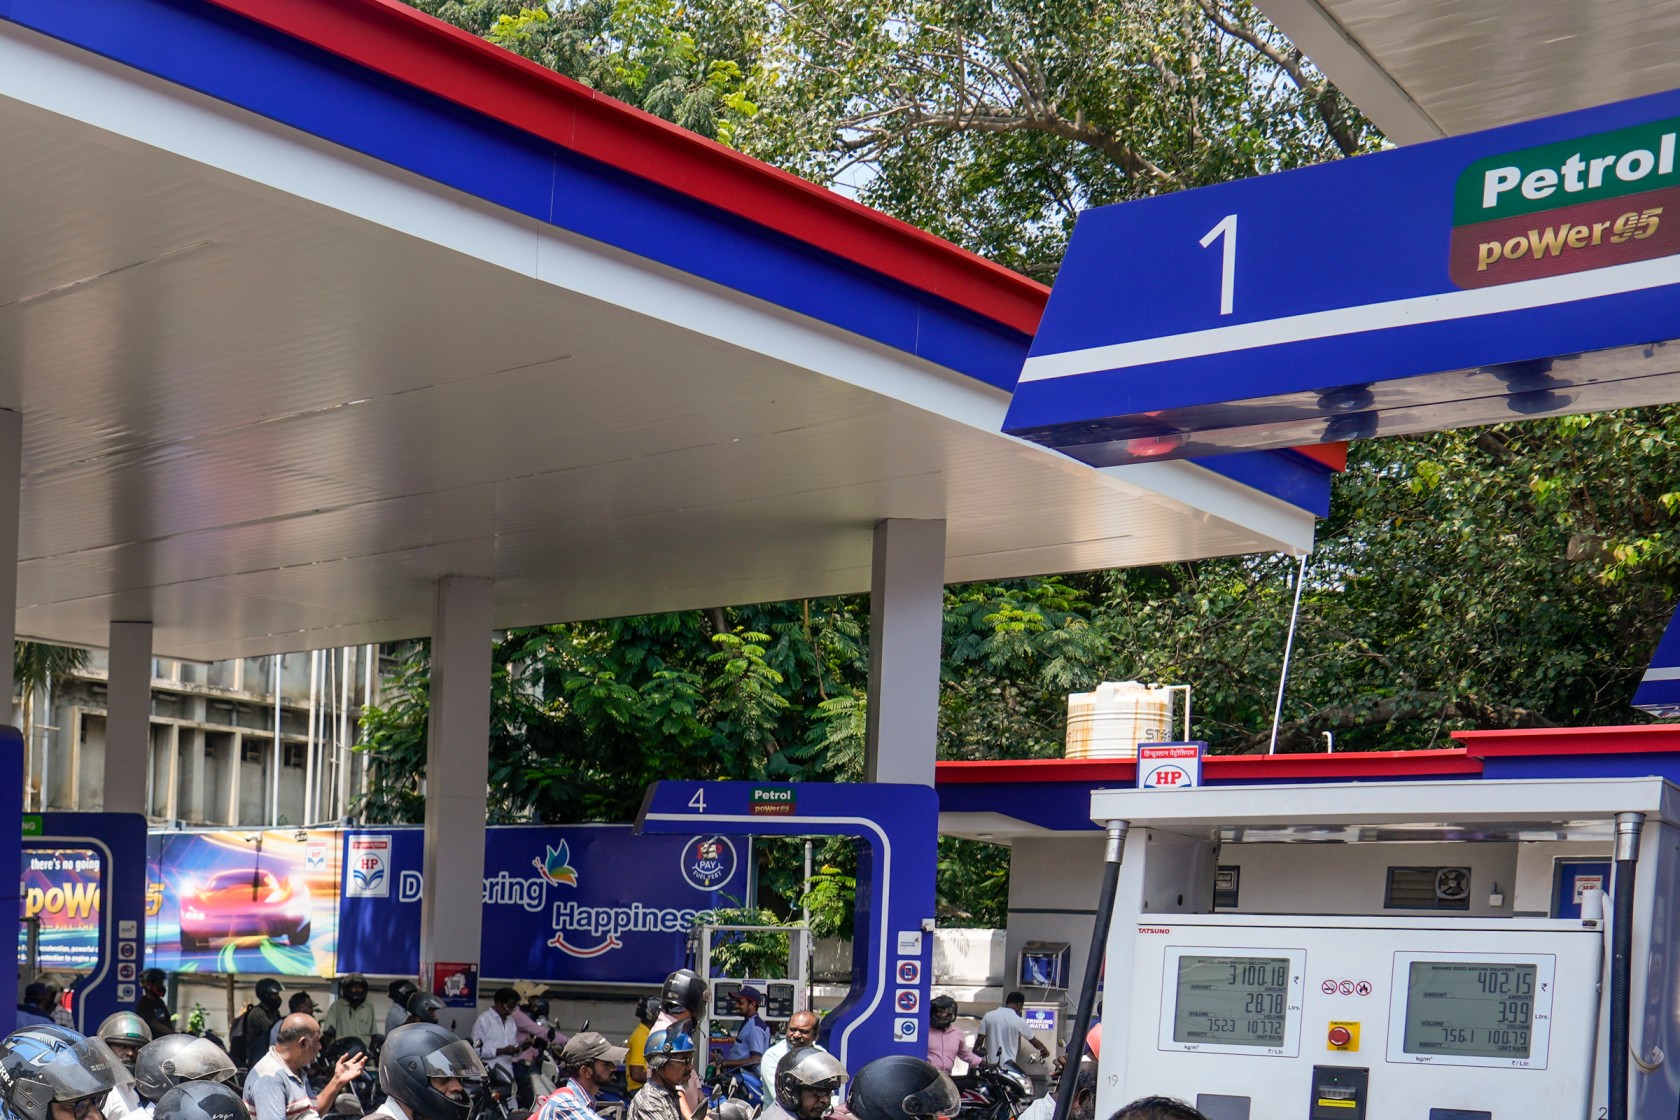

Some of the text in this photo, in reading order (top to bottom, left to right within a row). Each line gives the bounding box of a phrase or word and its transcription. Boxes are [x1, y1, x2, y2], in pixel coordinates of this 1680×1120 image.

[1482, 133, 1677, 209] Petrol
[1199, 214, 1238, 316] 1
[1155, 771, 1182, 785] HP
[687, 787, 707, 813] 4
[754, 790, 791, 800] Petrol
[30, 858, 101, 873] there's no going
[360, 858, 379, 870] HP
[699, 860, 717, 870] PAY
[1477, 971, 1532, 995] 402.15
[1245, 993, 1284, 1014] 28.78
[1497, 1001, 1529, 1024] 3.99
[1441, 1028, 1474, 1044] 756.1
[1488, 1030, 1528, 1046] 100.79
